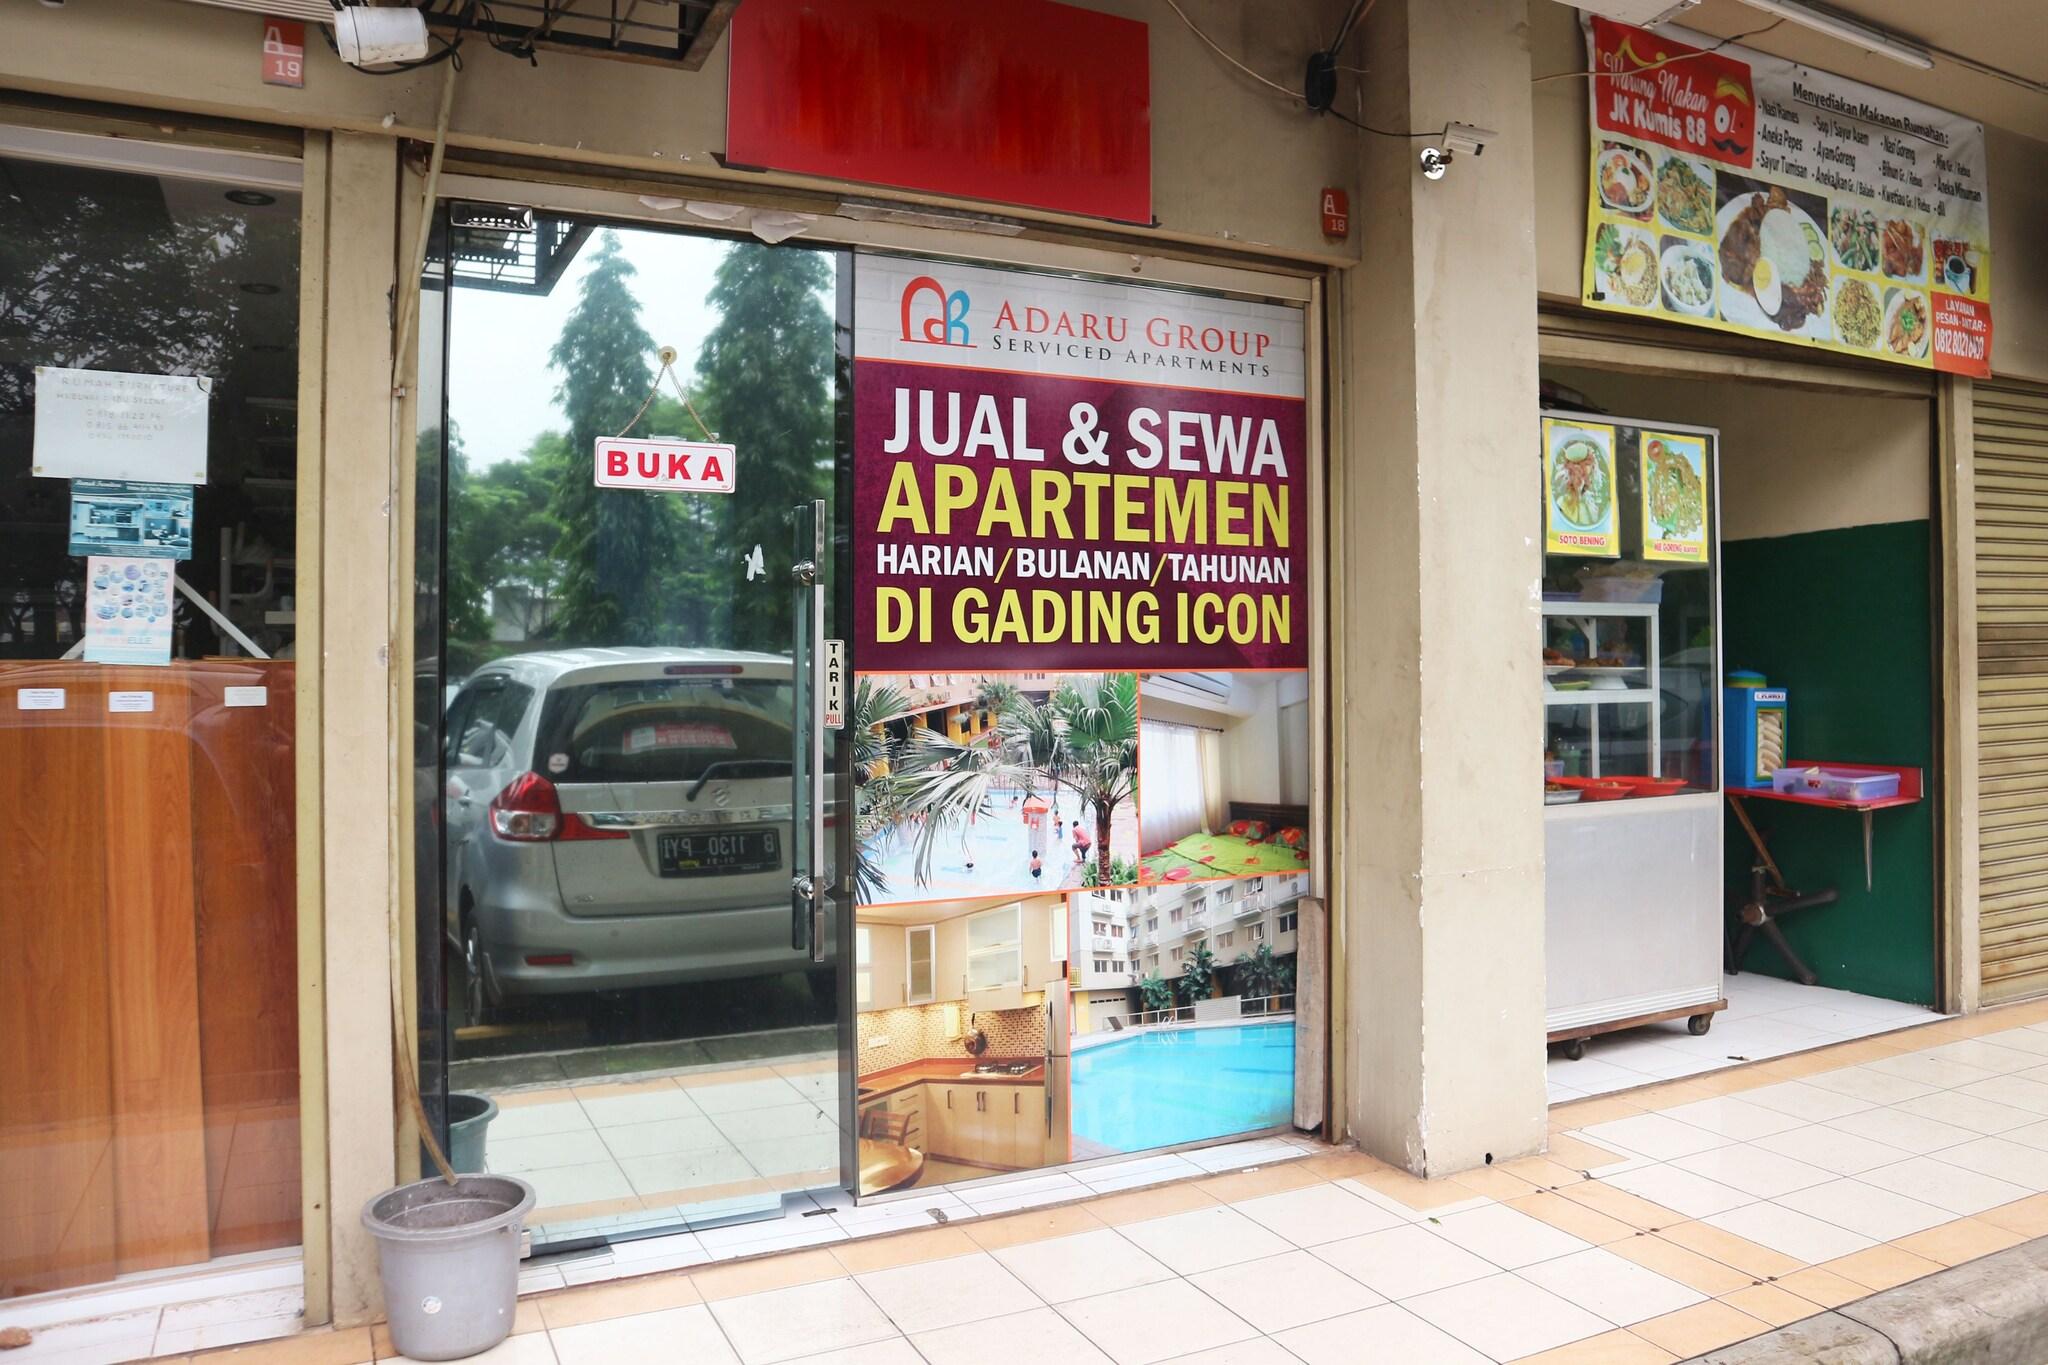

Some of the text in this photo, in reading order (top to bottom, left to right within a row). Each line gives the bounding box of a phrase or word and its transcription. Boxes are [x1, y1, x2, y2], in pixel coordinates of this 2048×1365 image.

[264, 26, 284, 53] A
[274, 59, 300, 78] 19
[1603, 52, 1710, 113] Warung Makan
[1609, 92, 1707, 146] JK Kumis 88
[1792, 81, 1858, 117] Menyediakan
[1859, 103, 1903, 129] Makanan
[1761, 123, 1803, 153] Aneka Pepes
[1815, 116, 1830, 138] Sop
[1833, 121, 1852, 143] Sayur
[1760, 150, 1808, 179] Sayur Tumisan
[1816, 140, 1856, 172] Ayam Goreng
[1883, 135, 1916, 166] Nasi Goreng
[1815, 166, 1835, 187] Aneka
[1323, 194, 1336, 214] A
[1331, 219, 1345, 231] 18
[993, 300, 1271, 358] ADARU GROUP
[992, 334, 1271, 378] SERVICED APARTMENTS
[883, 387, 1289, 478] JUAL & SEWA
[607, 450, 725, 482] BUKA
[876, 461, 1290, 548] APARTEMEN
[1559, 535, 1605, 546] SOTO BENING
[875, 586, 1291, 645] DI GADING ICON
[828, 643, 839, 711] TARIK
[825, 713, 842, 725] PULL
